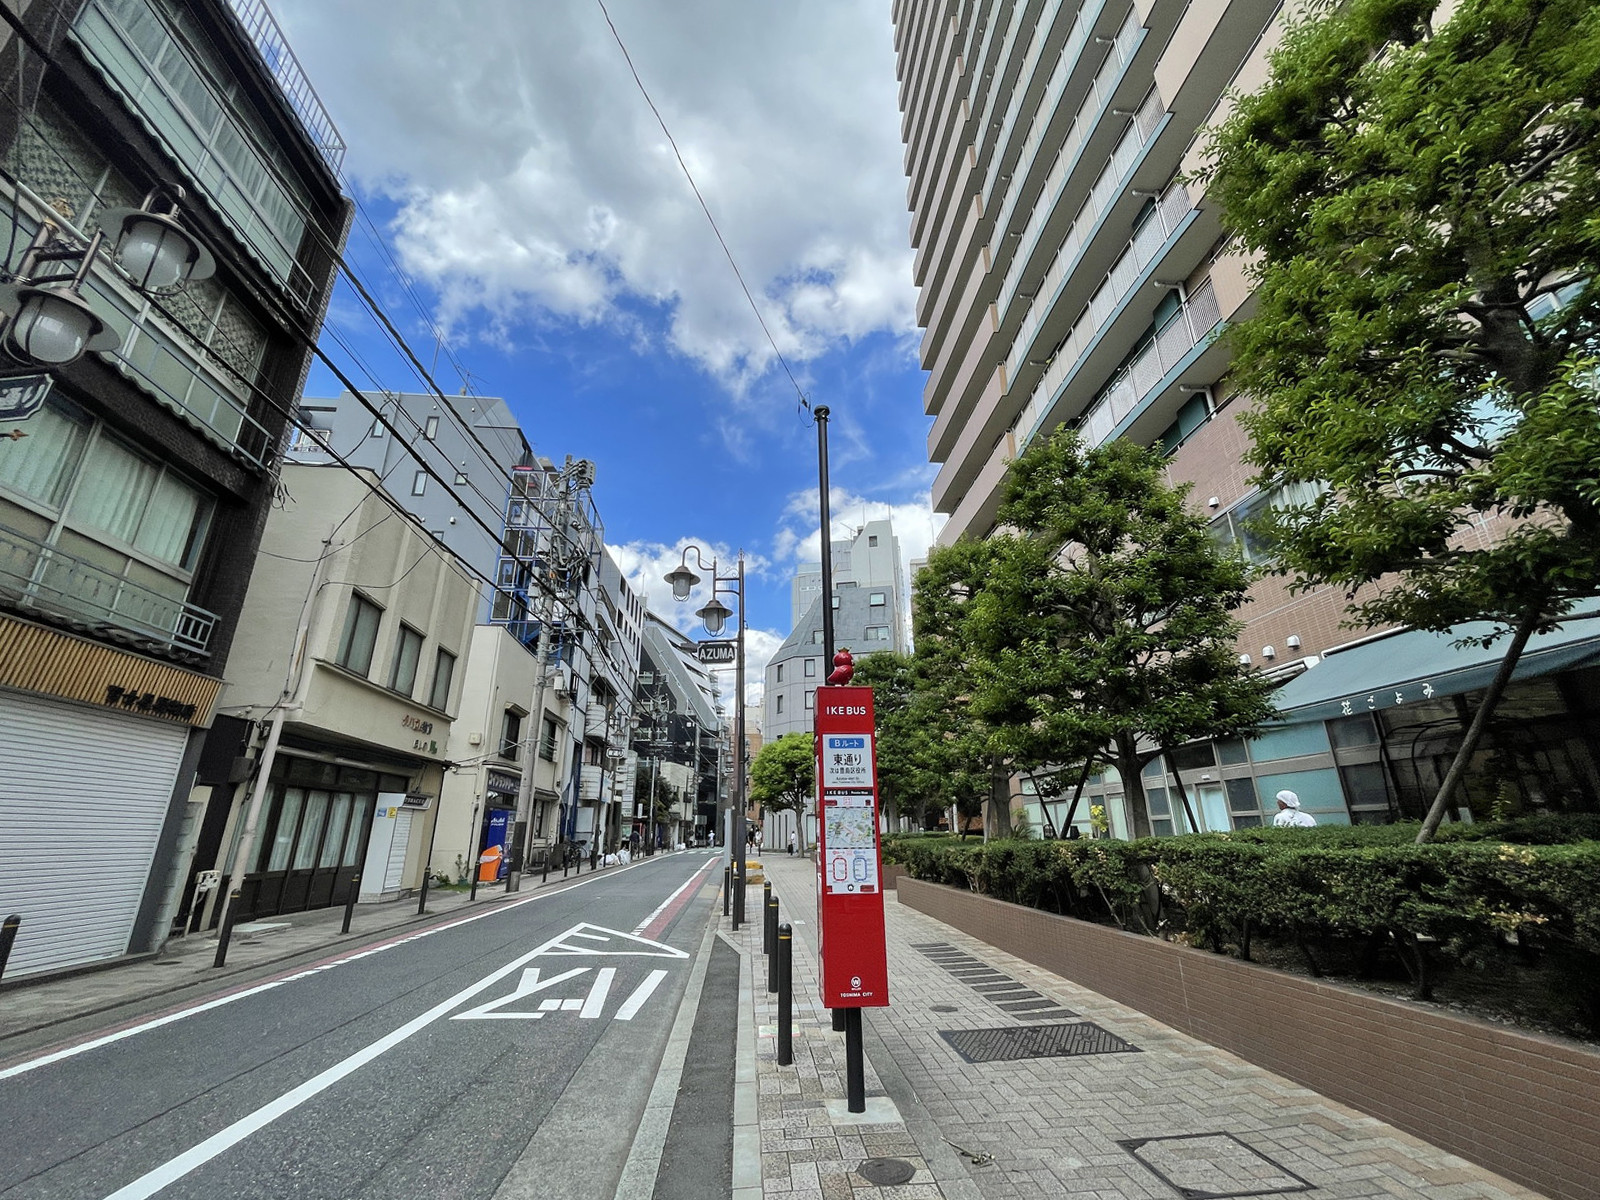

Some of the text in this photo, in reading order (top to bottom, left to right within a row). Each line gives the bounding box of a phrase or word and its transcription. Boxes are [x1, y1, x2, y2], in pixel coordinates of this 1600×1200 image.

[700, 648, 734, 660] AZUMA
[833, 753, 862, 766] 東通り
